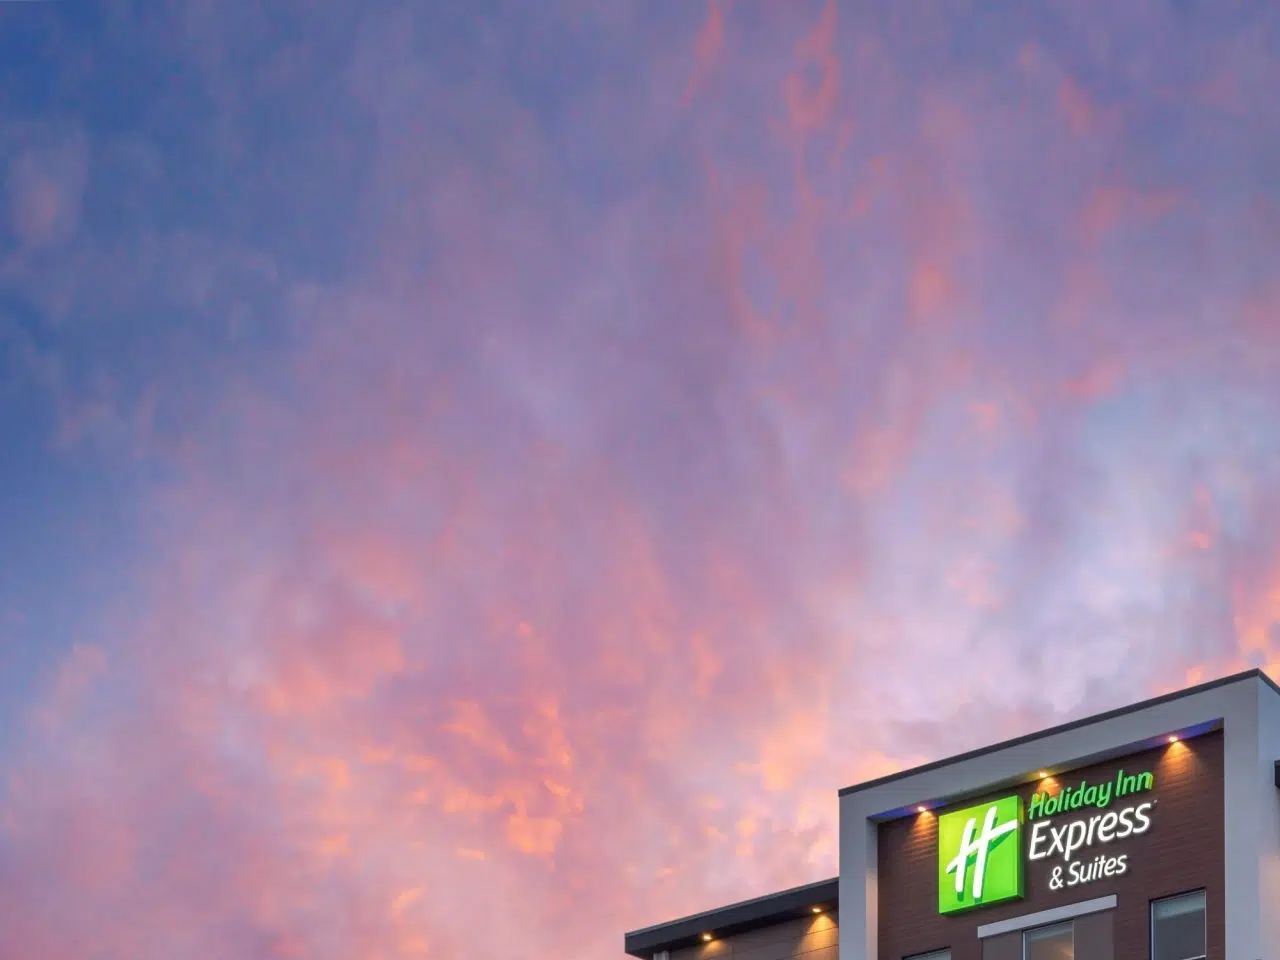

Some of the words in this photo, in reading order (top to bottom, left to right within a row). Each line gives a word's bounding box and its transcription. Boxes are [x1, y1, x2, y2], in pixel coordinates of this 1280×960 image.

[1028, 780, 1112, 821] Holiday
[1115, 768, 1154, 798] Inn
[1028, 802, 1152, 861] Express
[1048, 865, 1064, 891] &
[1067, 853, 1128, 887] Suites
